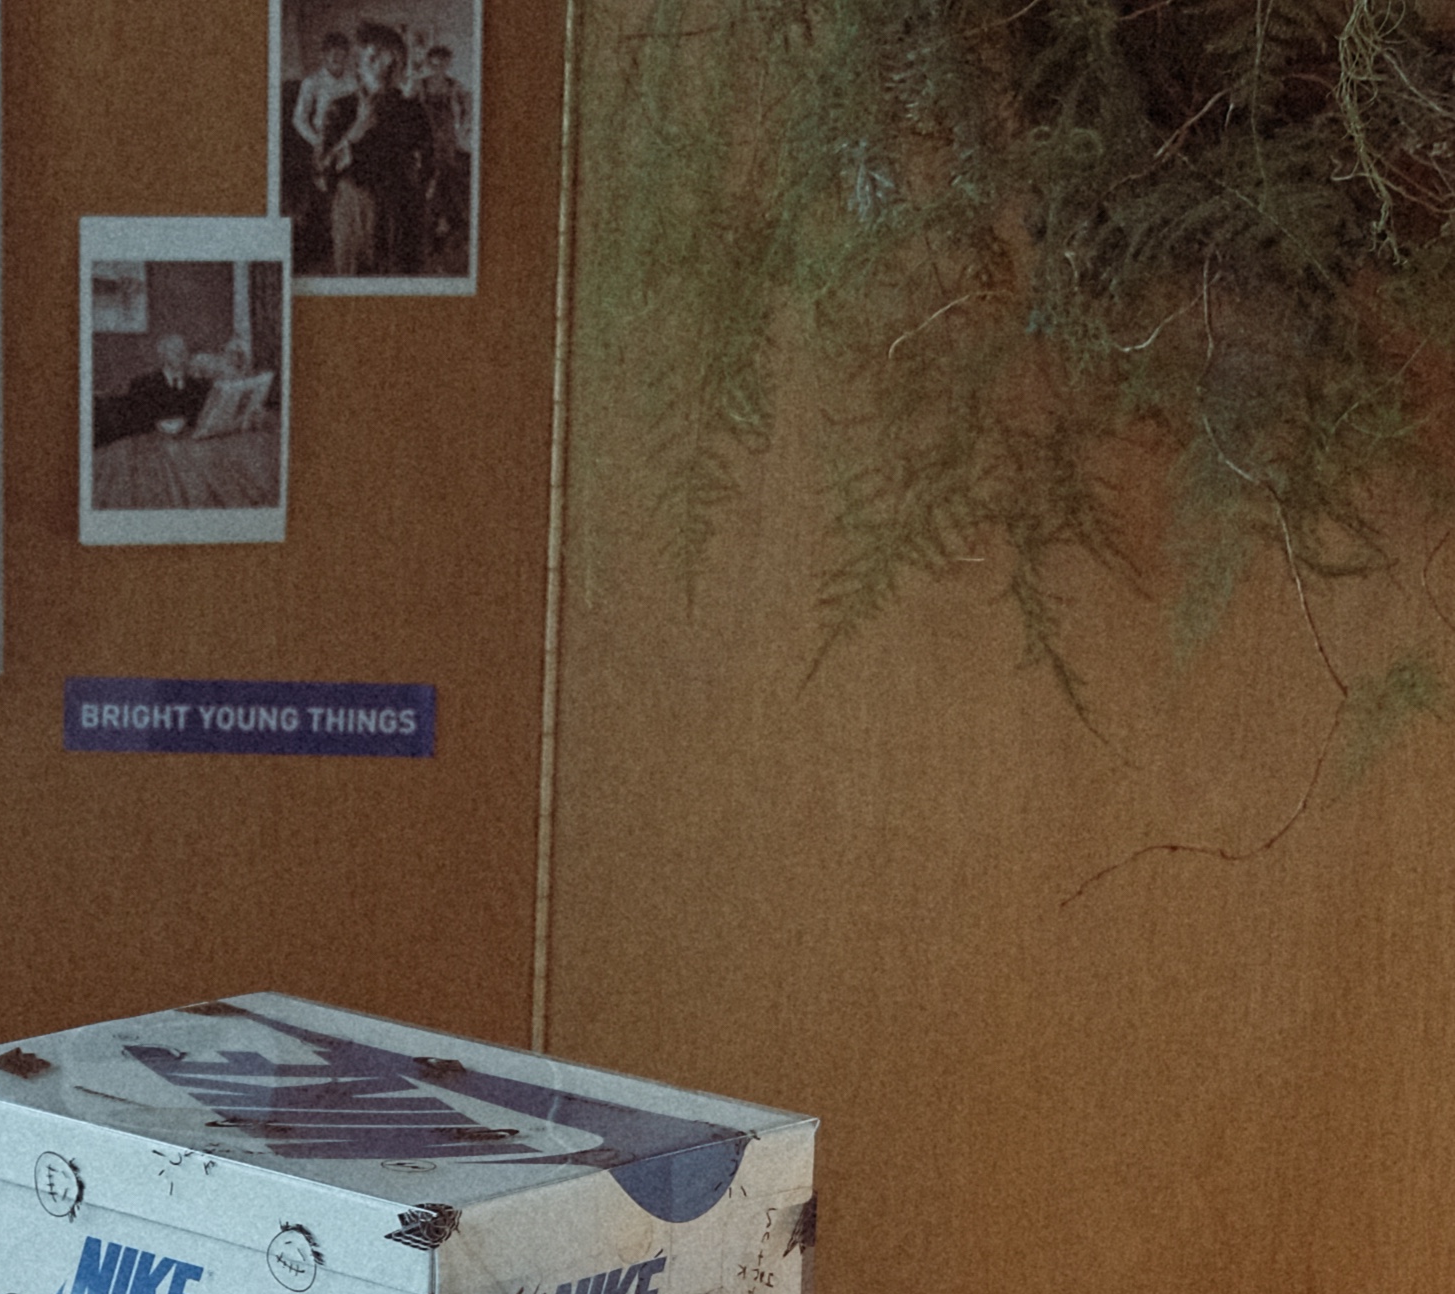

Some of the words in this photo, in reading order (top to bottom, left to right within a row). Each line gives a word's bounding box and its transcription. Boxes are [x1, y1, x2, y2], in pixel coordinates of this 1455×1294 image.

[81, 704, 190, 730] BRIGHT
[200, 706, 298, 732] YOUNG
[308, 707, 418, 735] THINGS
